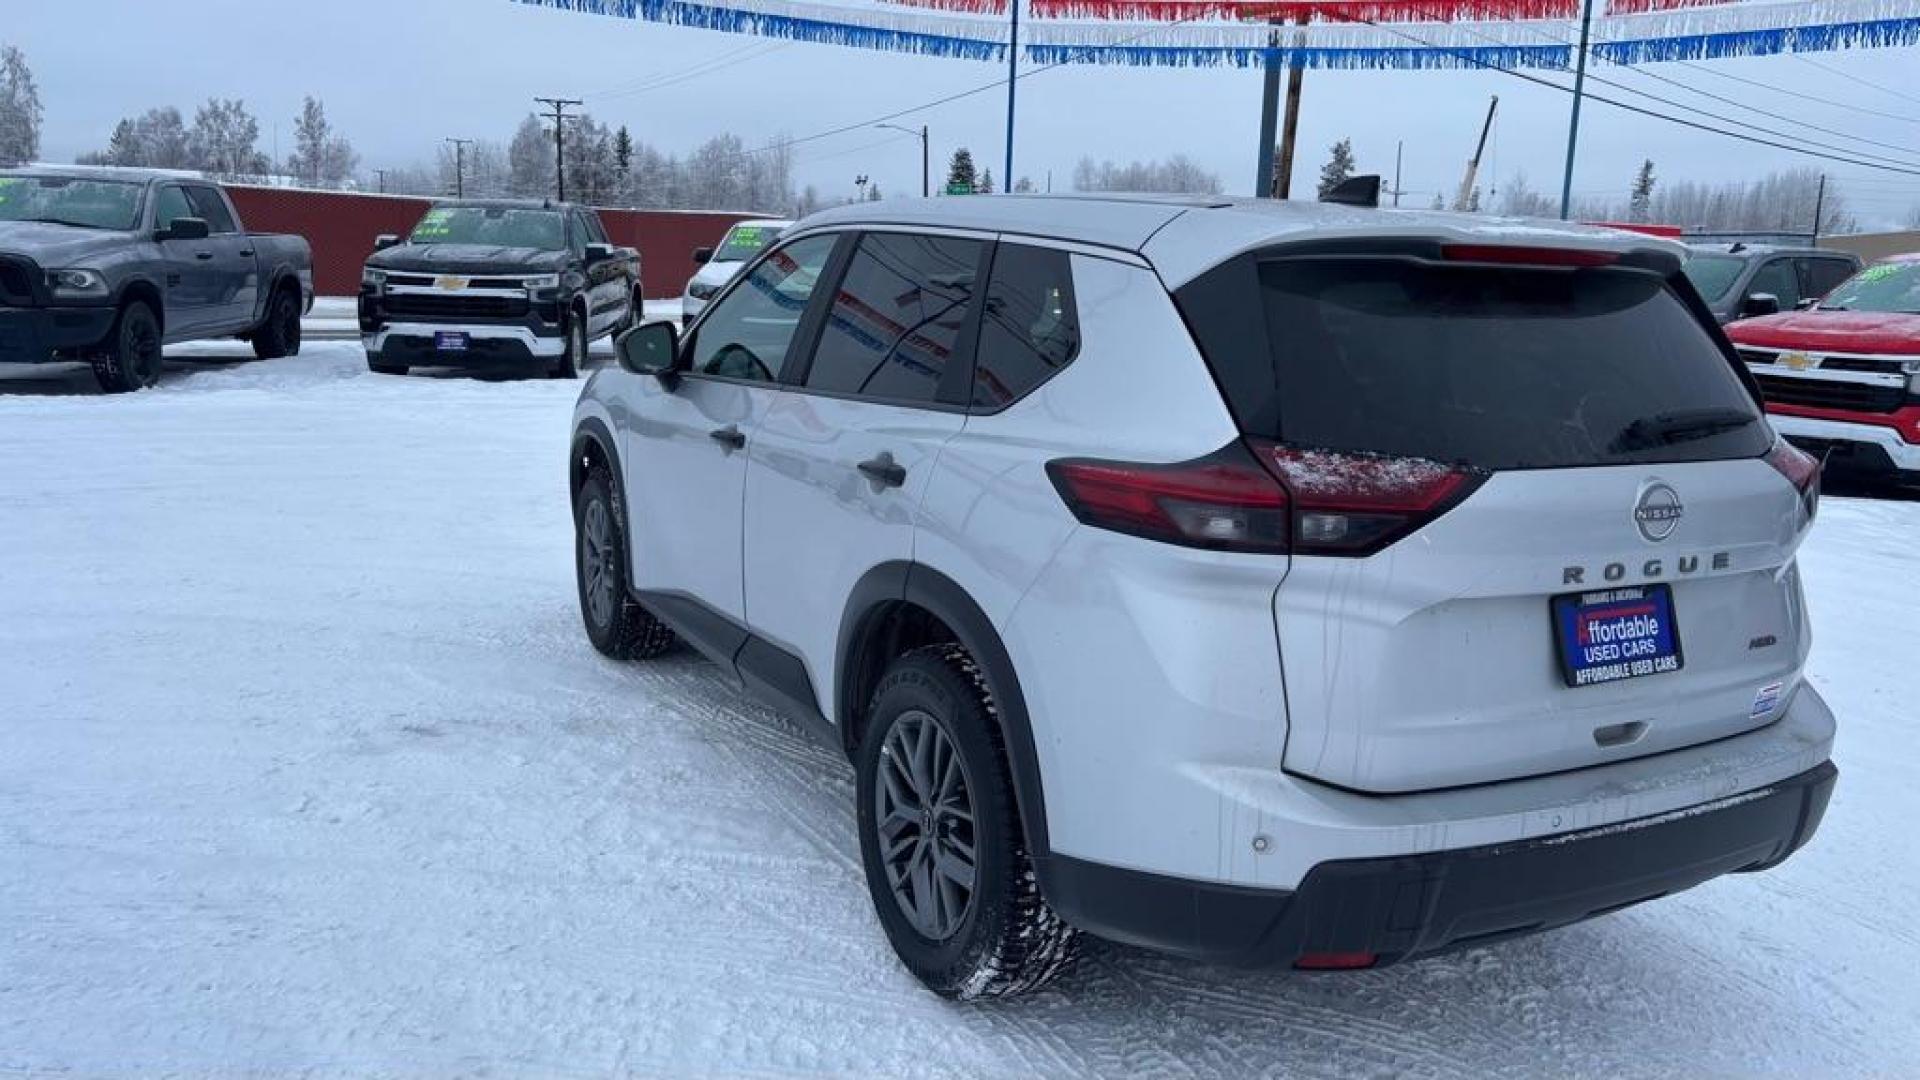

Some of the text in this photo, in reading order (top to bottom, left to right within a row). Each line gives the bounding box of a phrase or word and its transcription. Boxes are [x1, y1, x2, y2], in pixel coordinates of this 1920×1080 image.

[1637, 506, 1681, 519] NISSAN
[1563, 552, 1729, 584] ROGUE
[1577, 606, 1659, 645] Affordable
[1584, 639, 1656, 662] USED CARS
[1576, 655, 1677, 684] AFFORDABLE USED CARS
